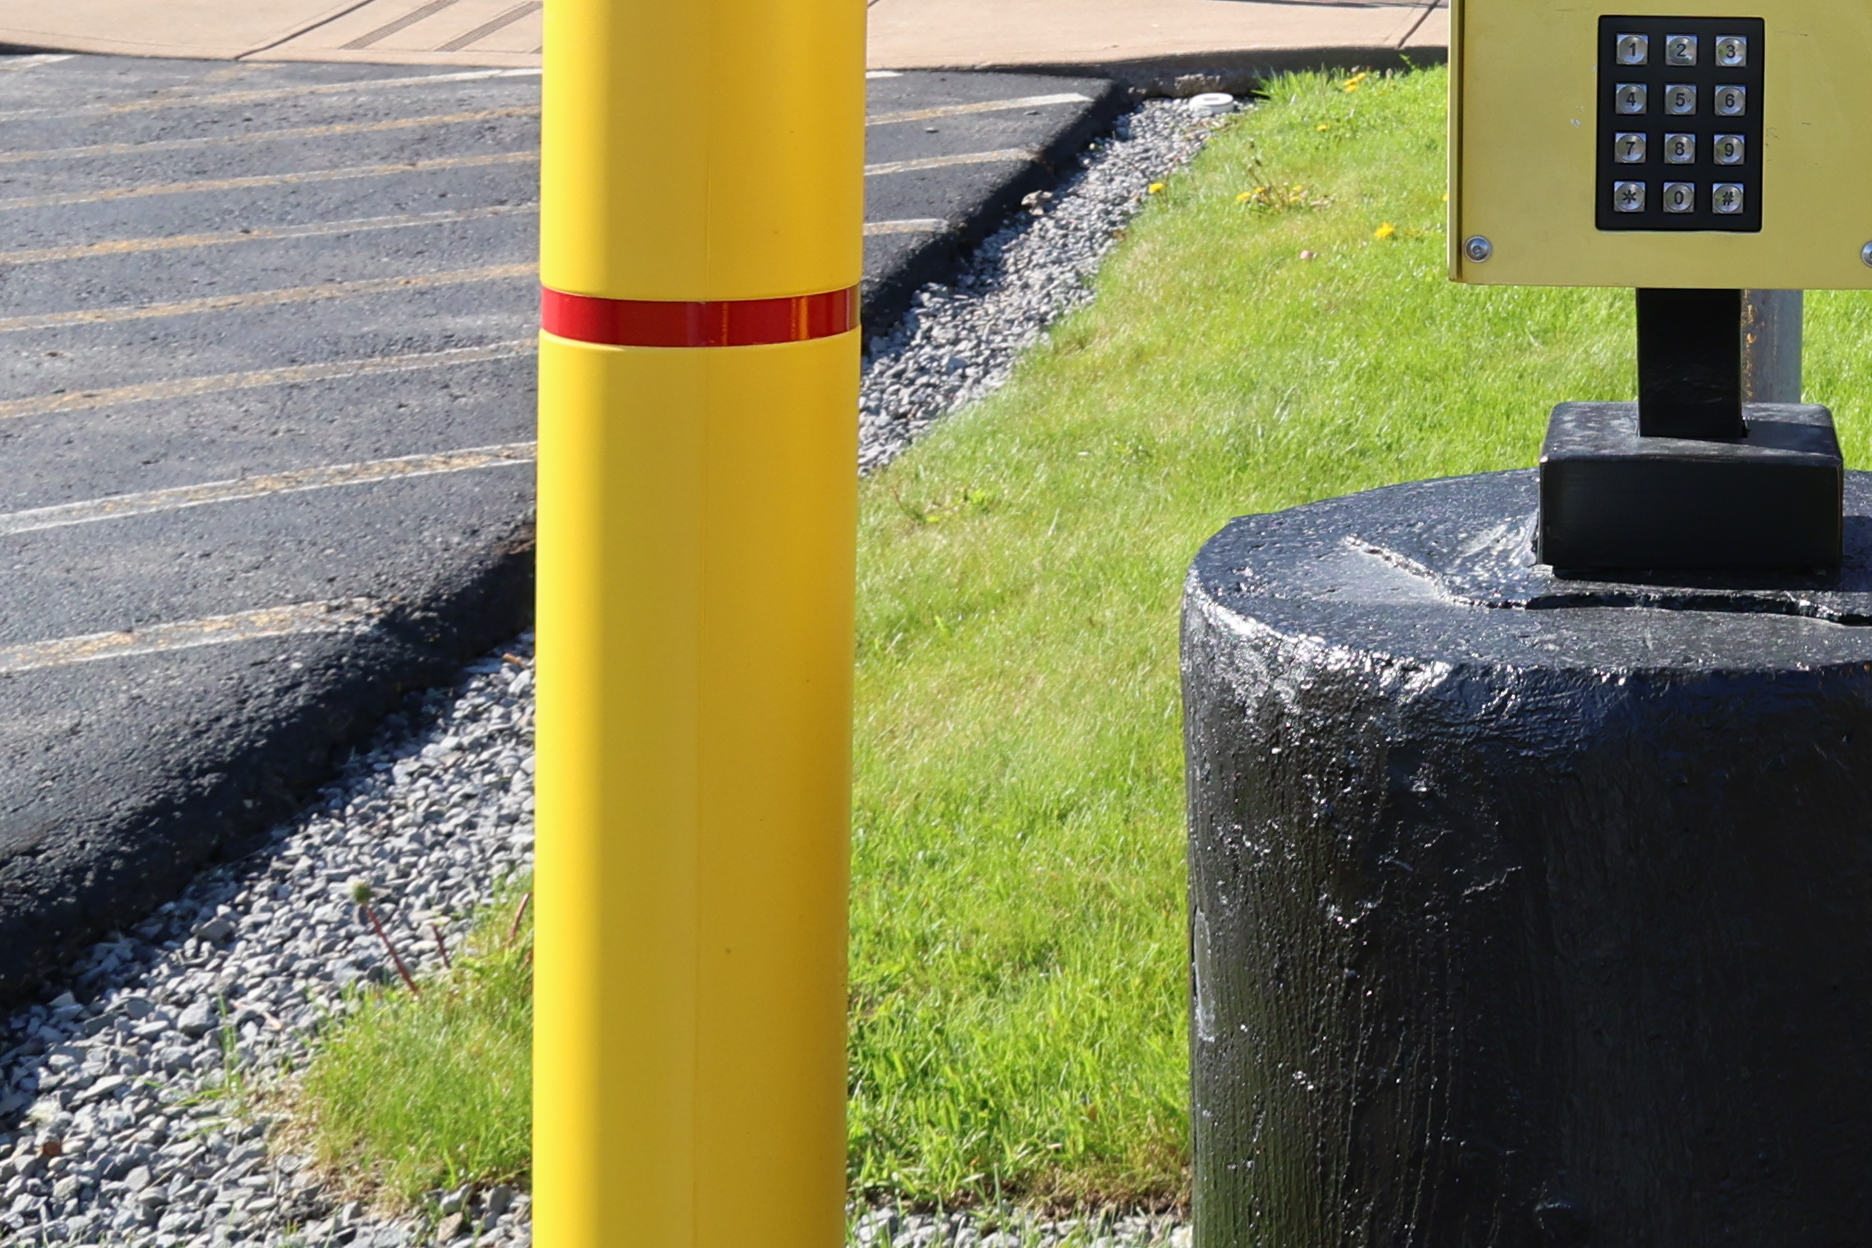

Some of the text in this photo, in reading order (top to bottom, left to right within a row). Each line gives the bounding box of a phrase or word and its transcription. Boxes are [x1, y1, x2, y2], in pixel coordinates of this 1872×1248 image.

[1629, 43, 1736, 59] 1 2 3
[1626, 92, 1735, 108] 4 5 6
[1626, 141, 1734, 158] 7 8 9
